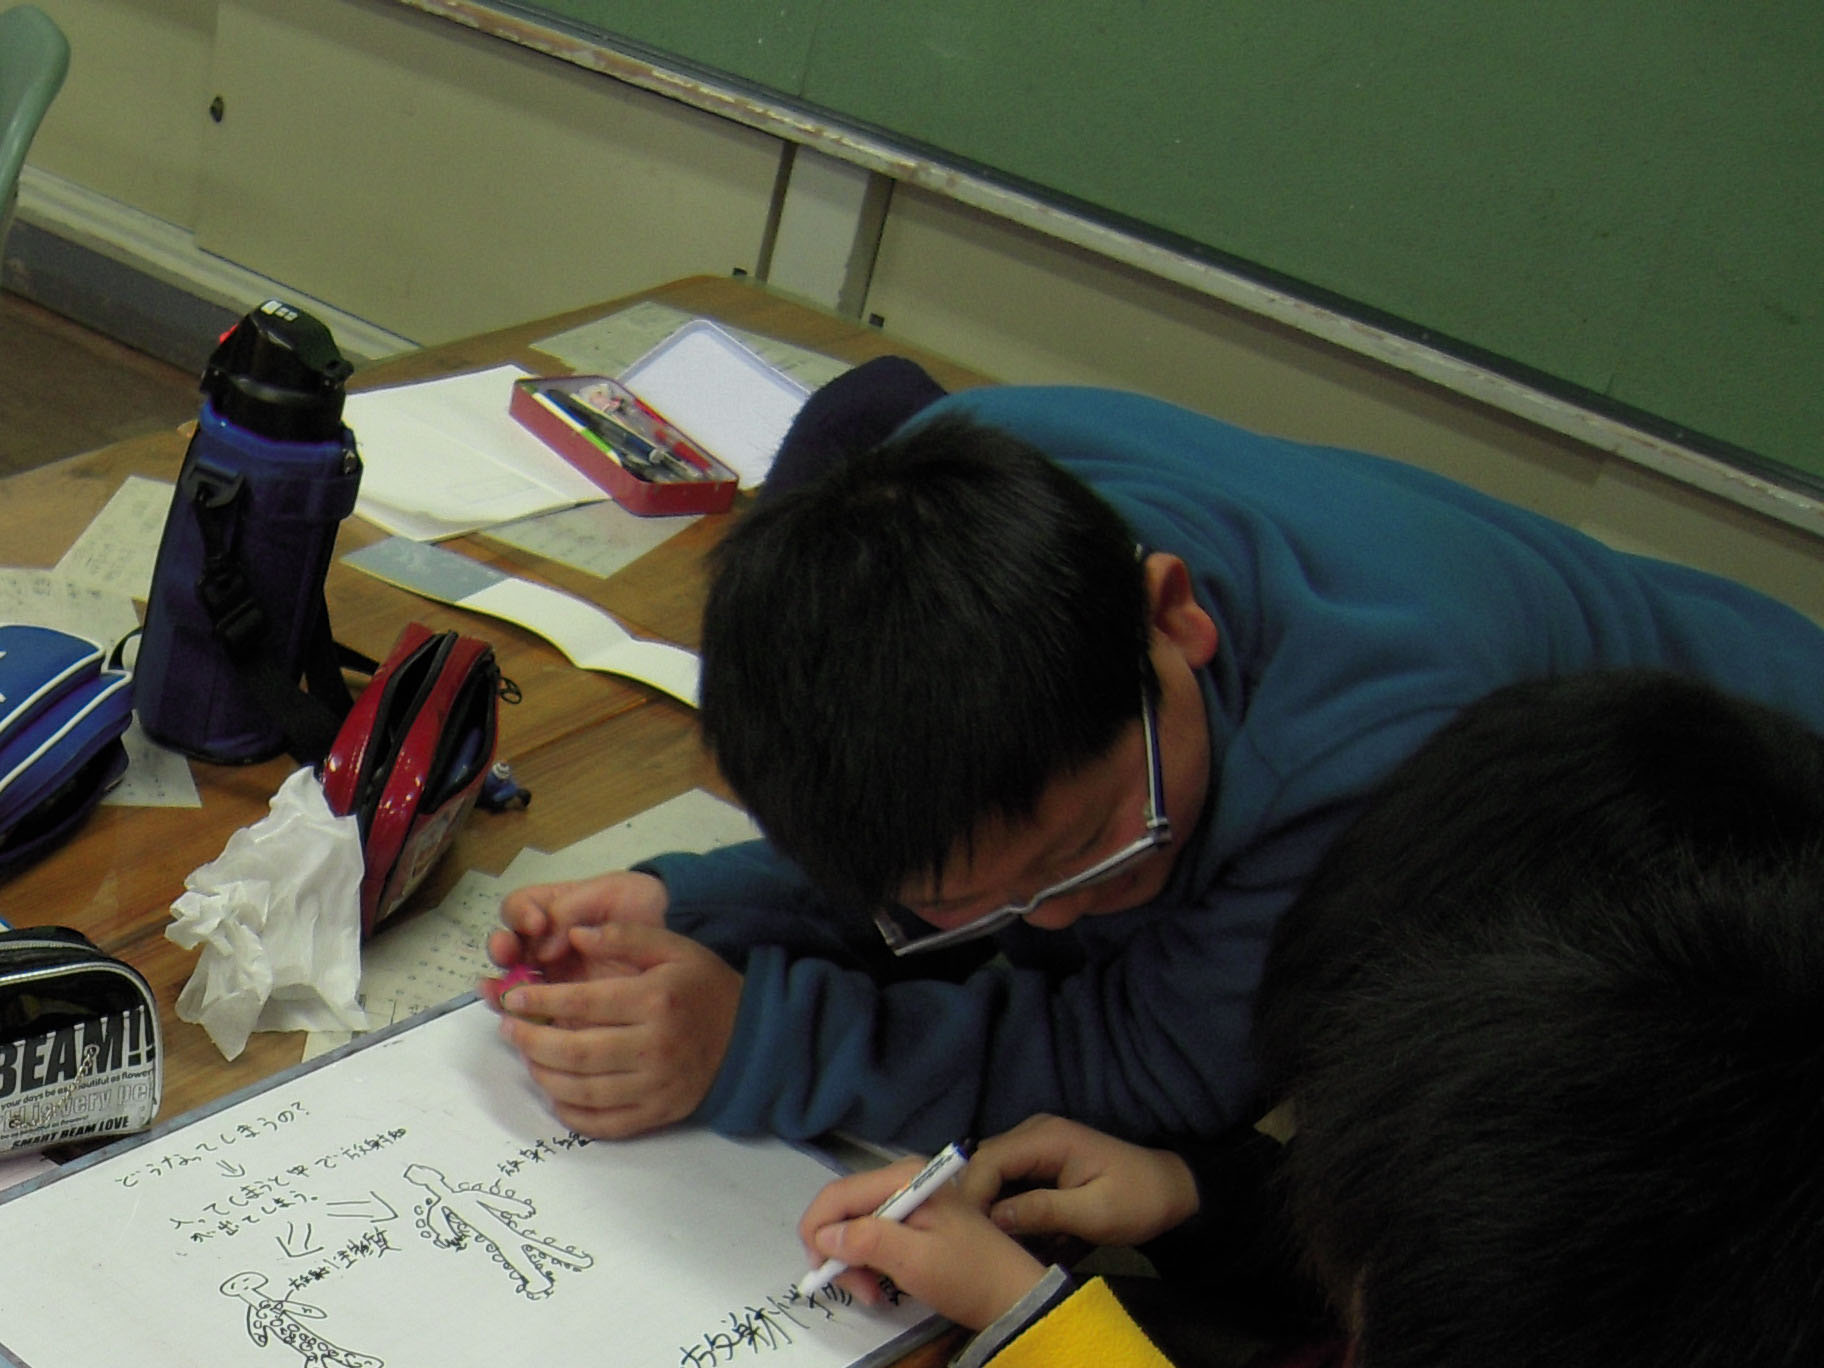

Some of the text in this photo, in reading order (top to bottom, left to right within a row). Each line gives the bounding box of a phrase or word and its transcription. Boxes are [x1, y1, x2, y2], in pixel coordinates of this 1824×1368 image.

[1, 1097, 23, 1110] your
[22, 1092, 44, 1104] days
[58, 1123, 97, 1140] BEAM
[98, 1116, 129, 1132] LOVE
